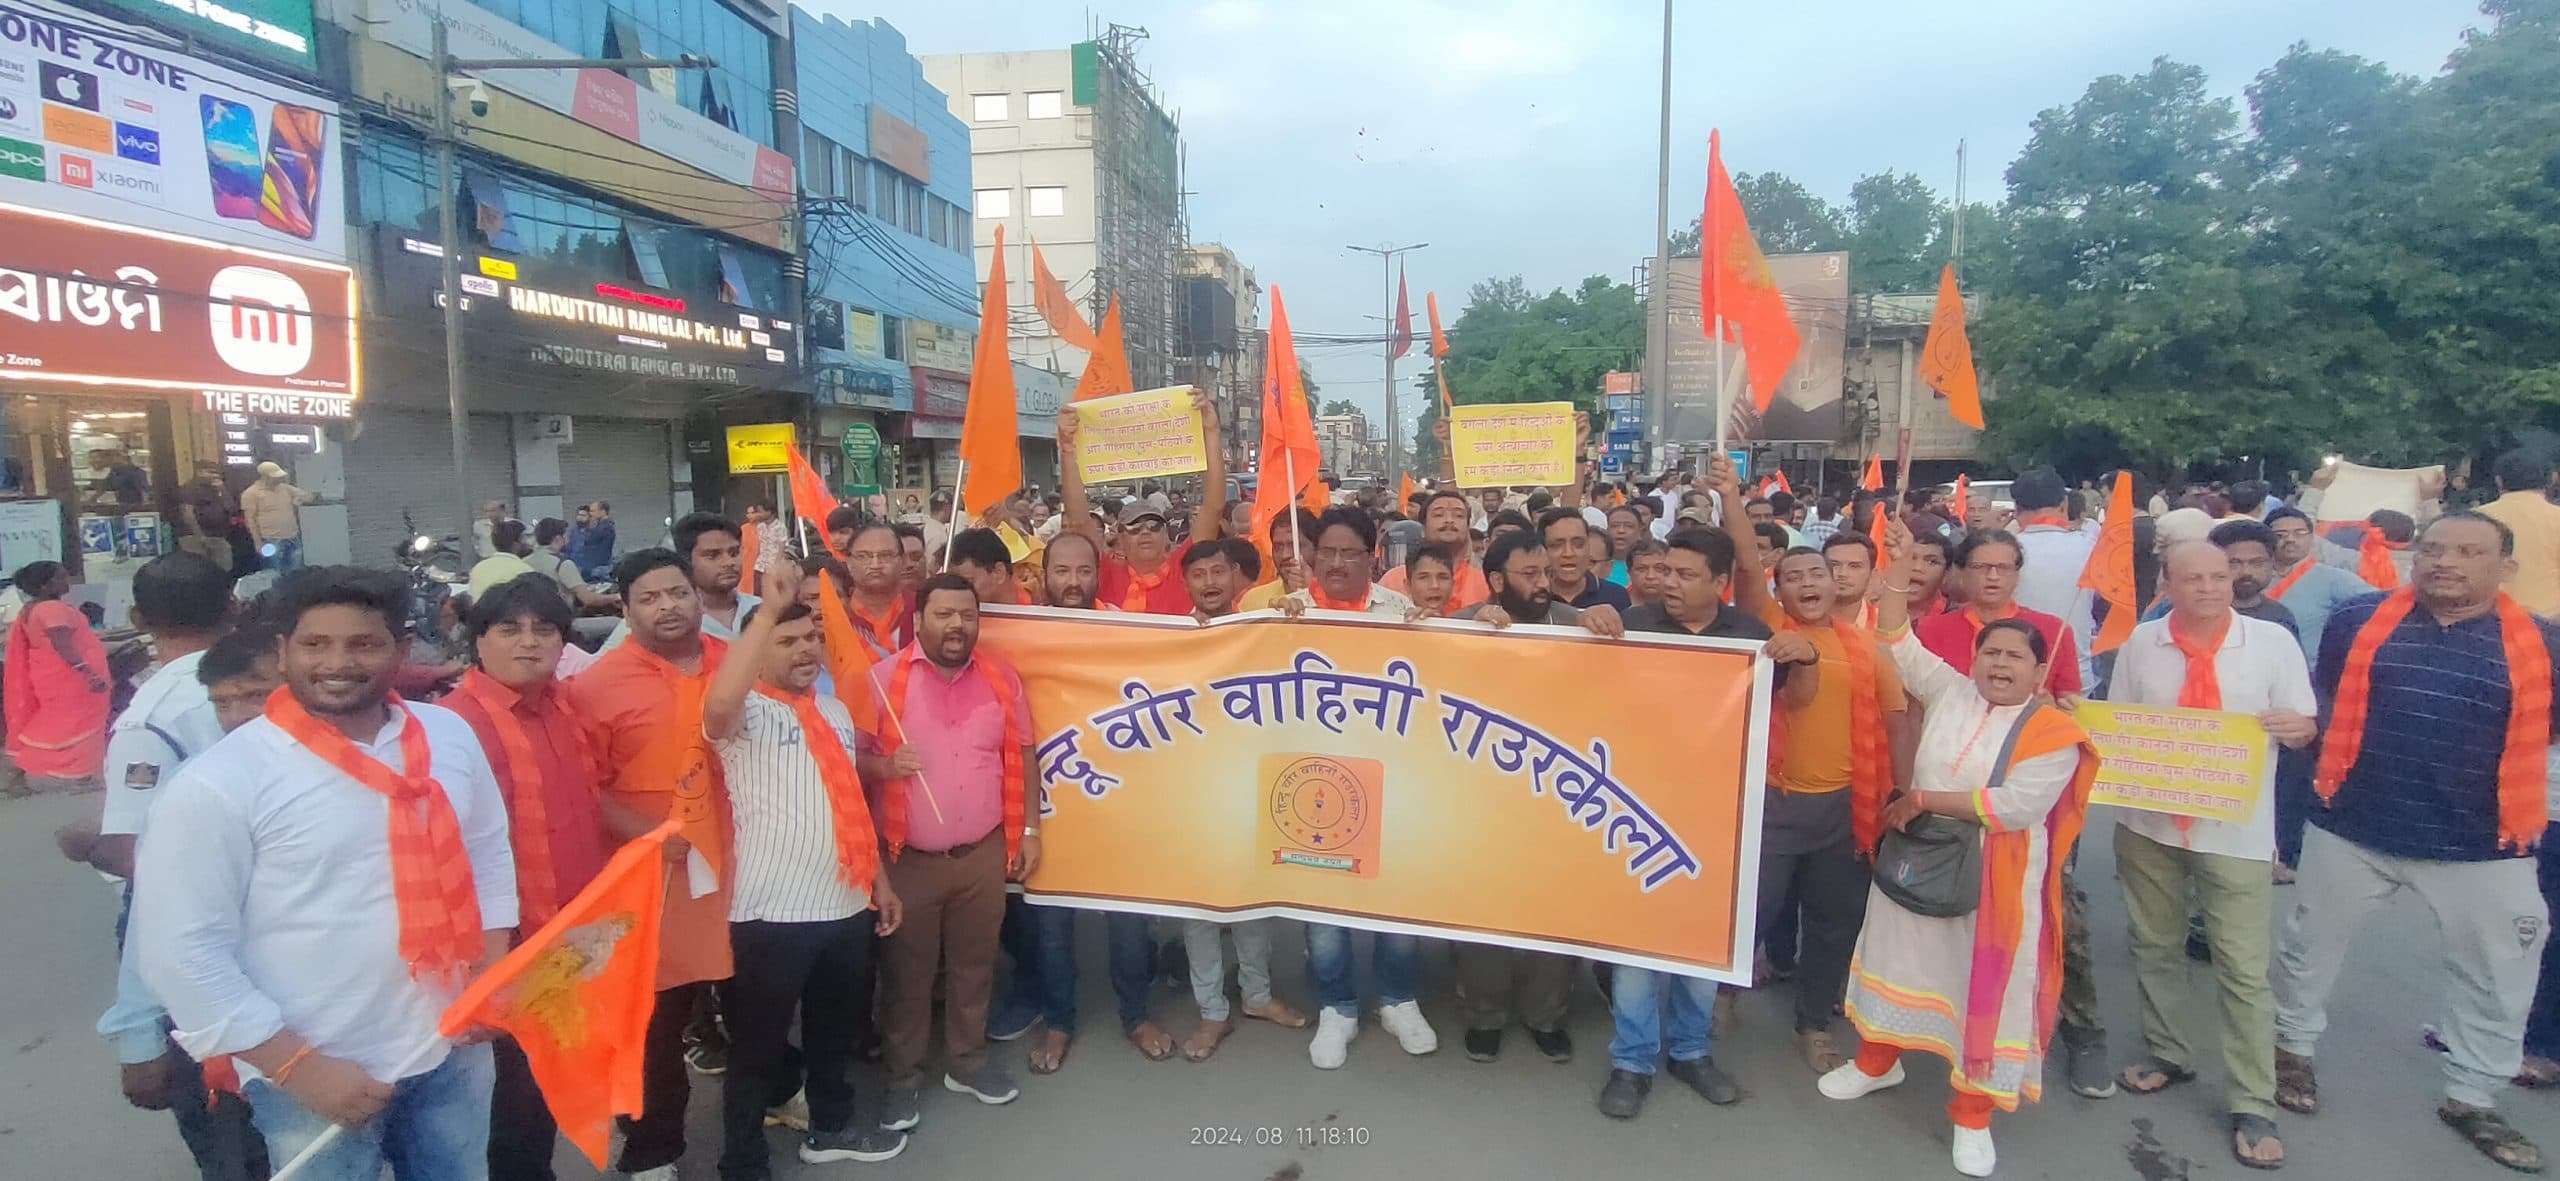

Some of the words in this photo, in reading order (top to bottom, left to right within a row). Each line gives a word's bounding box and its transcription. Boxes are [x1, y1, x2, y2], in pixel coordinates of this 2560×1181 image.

[93, 41, 187, 91] ZONE
[118, 134, 158, 153] vivo
[97, 170, 160, 194] xiaomi
[509, 286, 625, 329] HARDUTTRAI
[628, 308, 693, 340] RANGLAL
[695, 322, 720, 345] Pvt.
[722, 326, 747, 350] Ltd.
[7, 353, 43, 367] Zone
[202, 391, 244, 412] THE
[247, 393, 300, 415] FONE
[304, 397, 352, 418] ZONE
[2113, 710, 2143, 724] भारत
[1092, 680, 1204, 750] वीर
[1213, 652, 1423, 736] वाहिनी
[1440, 694, 1696, 892] राउरकेला
[1299, 760, 1339, 778] वाहिनी
